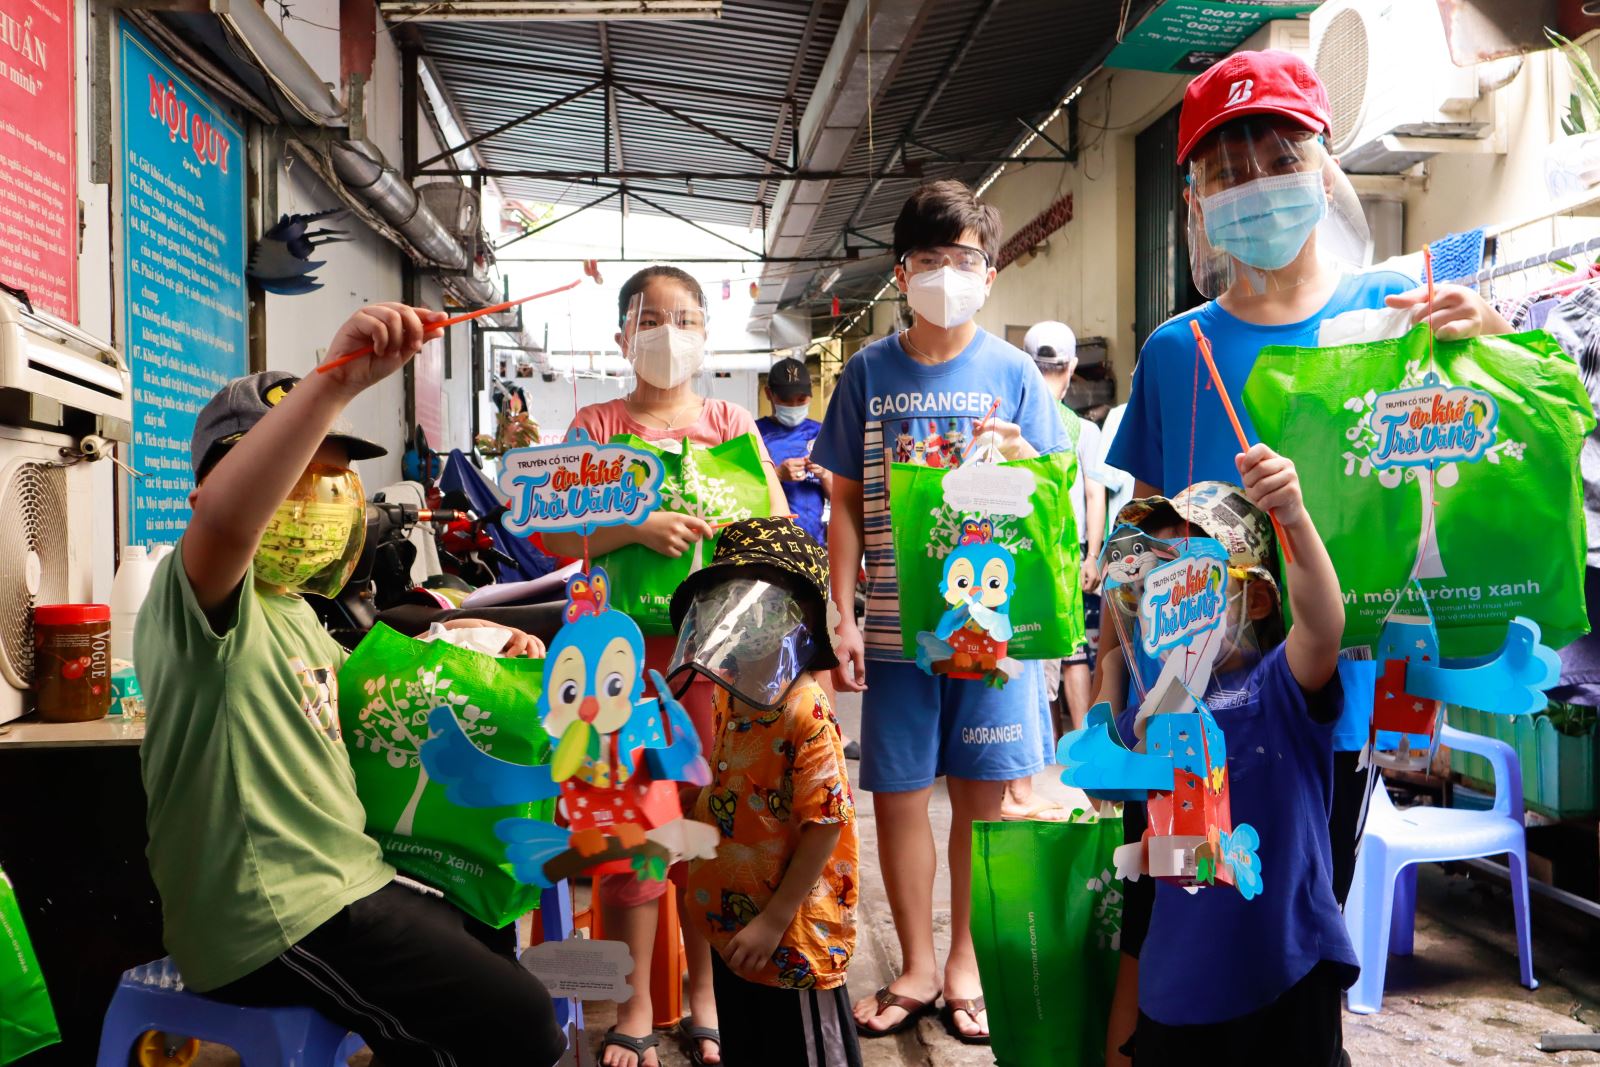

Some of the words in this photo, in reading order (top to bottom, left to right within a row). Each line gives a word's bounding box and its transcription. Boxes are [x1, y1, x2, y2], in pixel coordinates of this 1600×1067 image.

[1202, 8, 1260, 19] 14.000
[147, 72, 189, 144] NỘI
[191, 114, 230, 176] QUY
[868, 391, 993, 417] GAORANGER
[1406, 584, 1482, 602] trường
[1488, 580, 1541, 597] xanh
[1012, 621, 1042, 634] xanh
[91, 630, 112, 679] VOGUE
[961, 723, 1023, 746] GAORANGER
[446, 854, 485, 878] xanh
